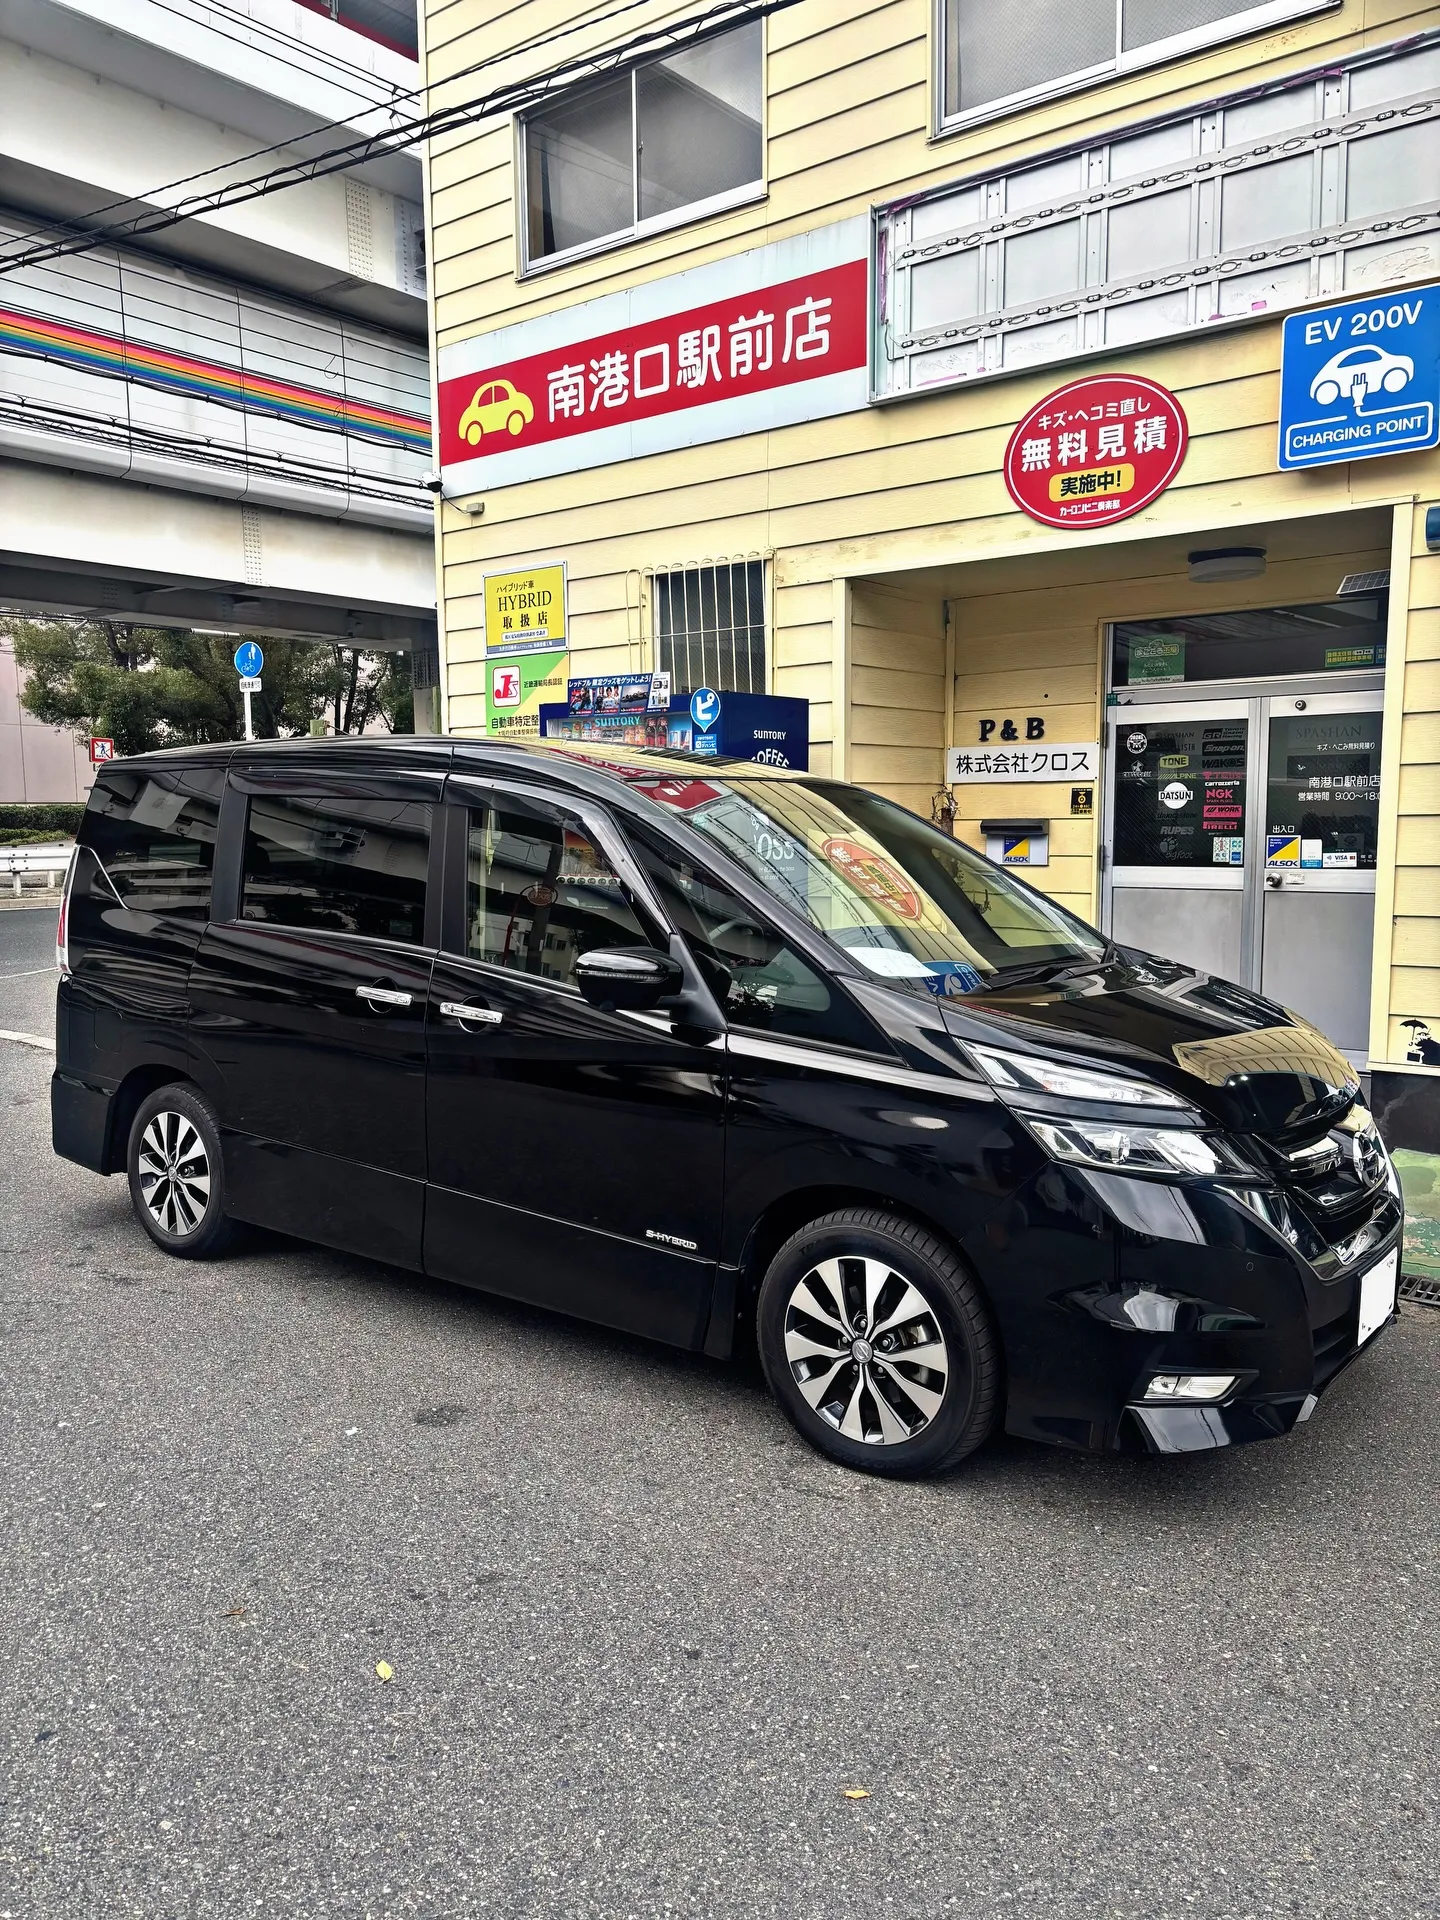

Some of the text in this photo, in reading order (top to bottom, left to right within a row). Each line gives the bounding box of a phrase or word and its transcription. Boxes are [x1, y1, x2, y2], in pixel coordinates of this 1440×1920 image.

[1305, 299, 1423, 346] EV 200V
[546, 295, 833, 423] 南港口駅前店
[1292, 414, 1425, 449] CHARGING POINT
[1020, 415, 1168, 473] 無料見積
[496, 580, 535, 593] ハイブリッド車
[498, 590, 552, 612] HYBRID
[503, 610, 548, 629] 取扱店
[695, 692, 716, 720] ピ
[594, 715, 641, 727] SUNTORY
[753, 729, 787, 741] SUNTORY
[978, 717, 1045, 742] P & B
[1296, 725, 1362, 739] SPASHAN
[955, 752, 1090, 775] 株式会社クロス
[1161, 756, 1188, 766] TONE
[1308, 774, 1381, 789] 南港口駅前店
[1160, 791, 1192, 800] DATSUN
[1206, 788, 1233, 799] NGK
[1298, 792, 1330, 801] 営業時間
[1160, 826, 1195, 835] RUPES
[1272, 825, 1295, 834] 出入口
[645, 1229, 698, 1250] S-HYBRID
